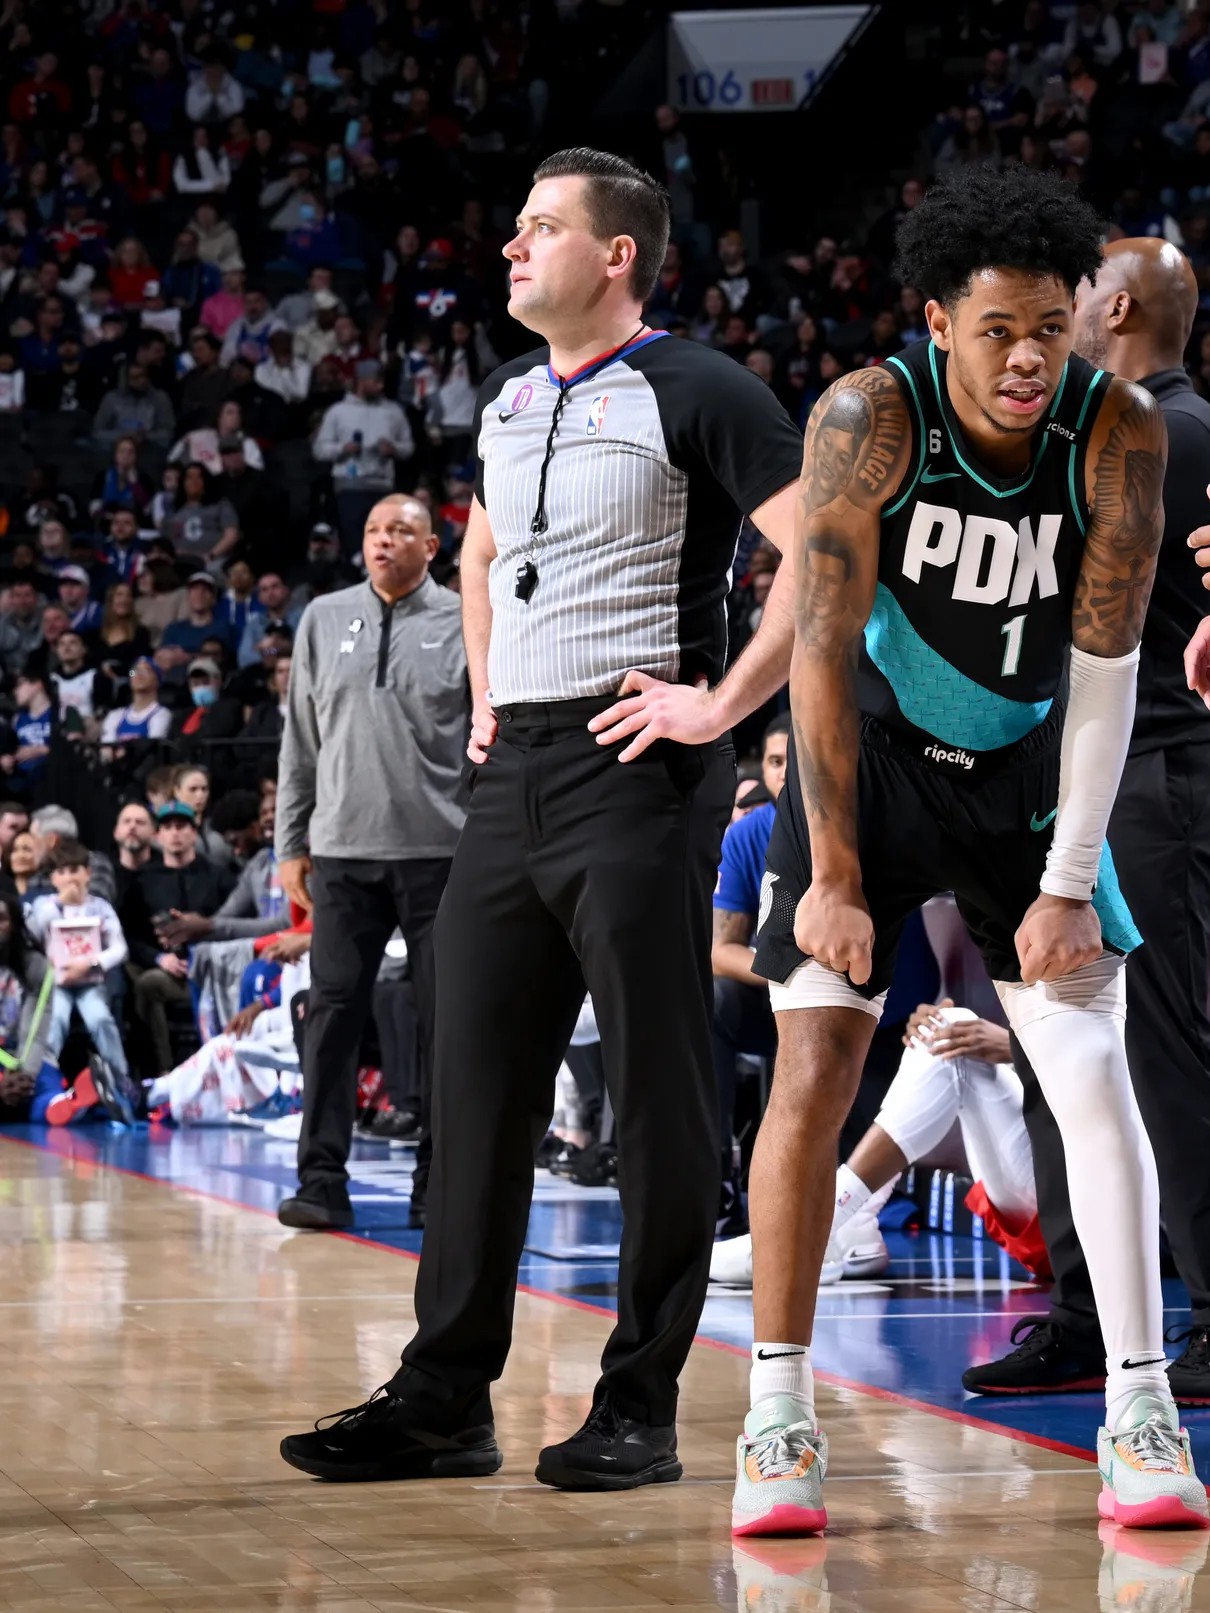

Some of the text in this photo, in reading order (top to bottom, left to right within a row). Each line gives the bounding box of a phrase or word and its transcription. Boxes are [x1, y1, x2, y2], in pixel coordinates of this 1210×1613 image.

[677, 69, 743, 104] 106
[929, 428, 942, 454] 6
[902, 500, 1063, 608] PDX
[1000, 614, 1028, 677] 1
[924, 744, 975, 769] ripcity
